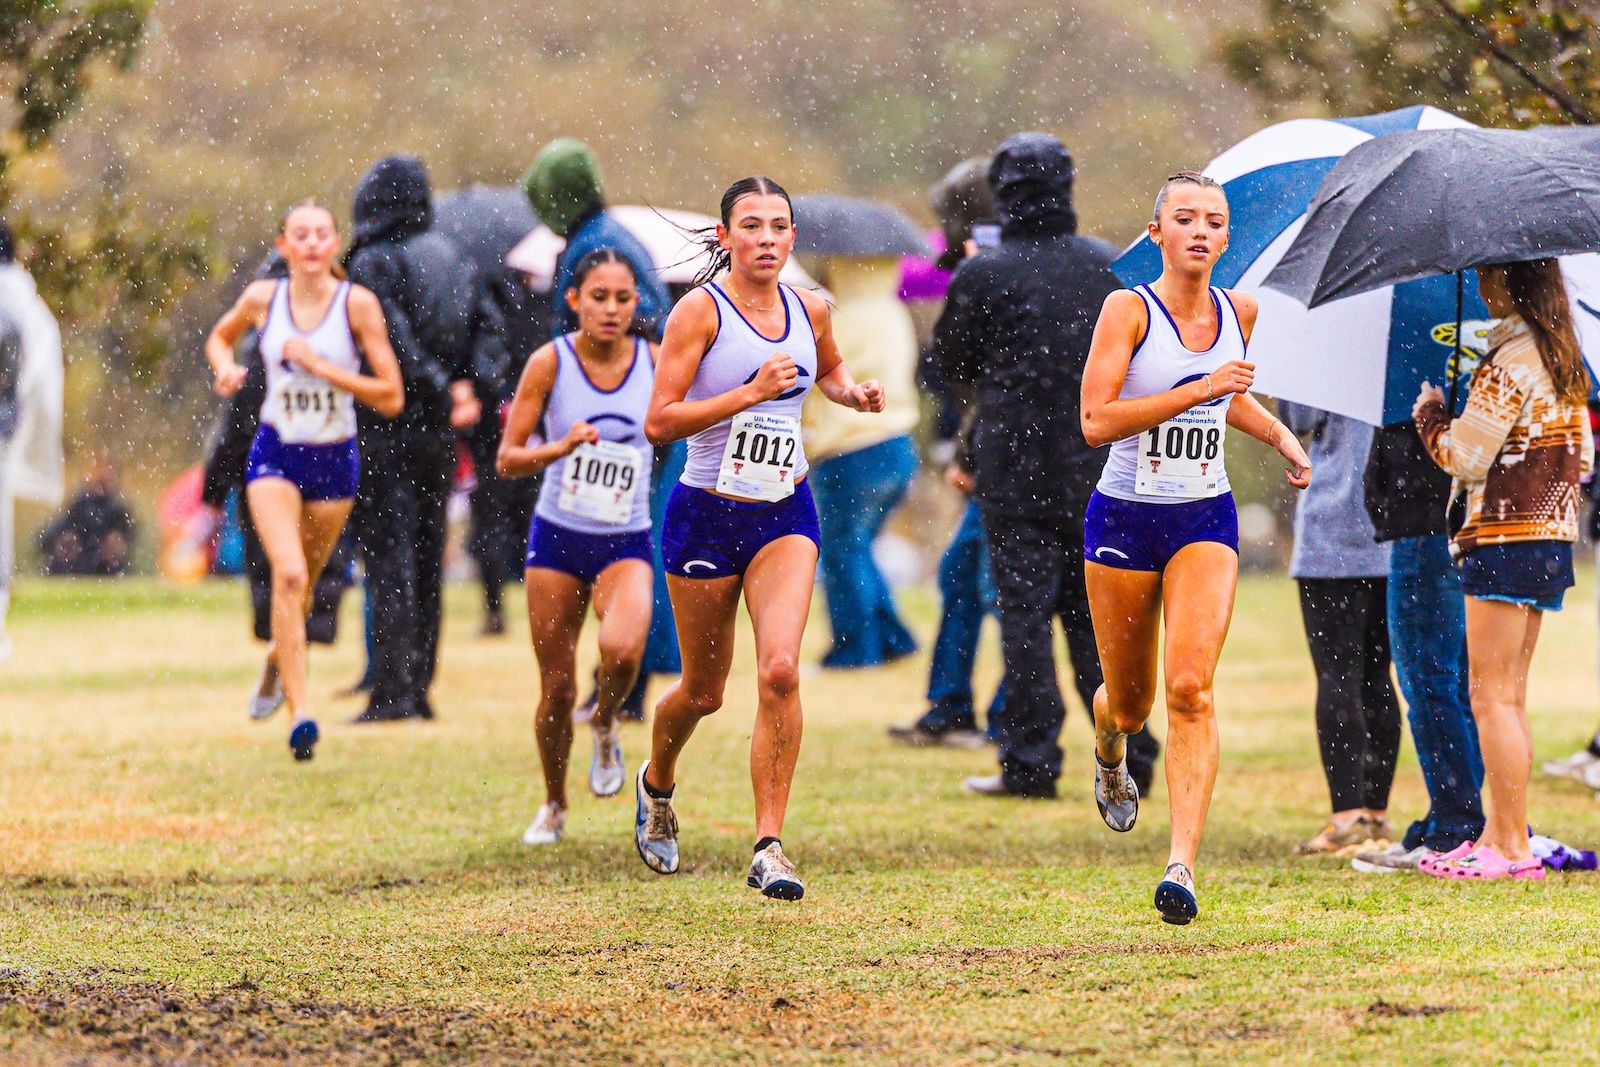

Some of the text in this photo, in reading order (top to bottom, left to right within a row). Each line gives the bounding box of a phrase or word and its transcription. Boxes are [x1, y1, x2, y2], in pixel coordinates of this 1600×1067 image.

[283, 389, 335, 412] 1011
[754, 415, 765, 423] UIL
[767, 417, 786, 425] Region
[731, 430, 795, 468] 1012
[1146, 425, 1220, 460] 1008
[571, 455, 634, 492] 1009
